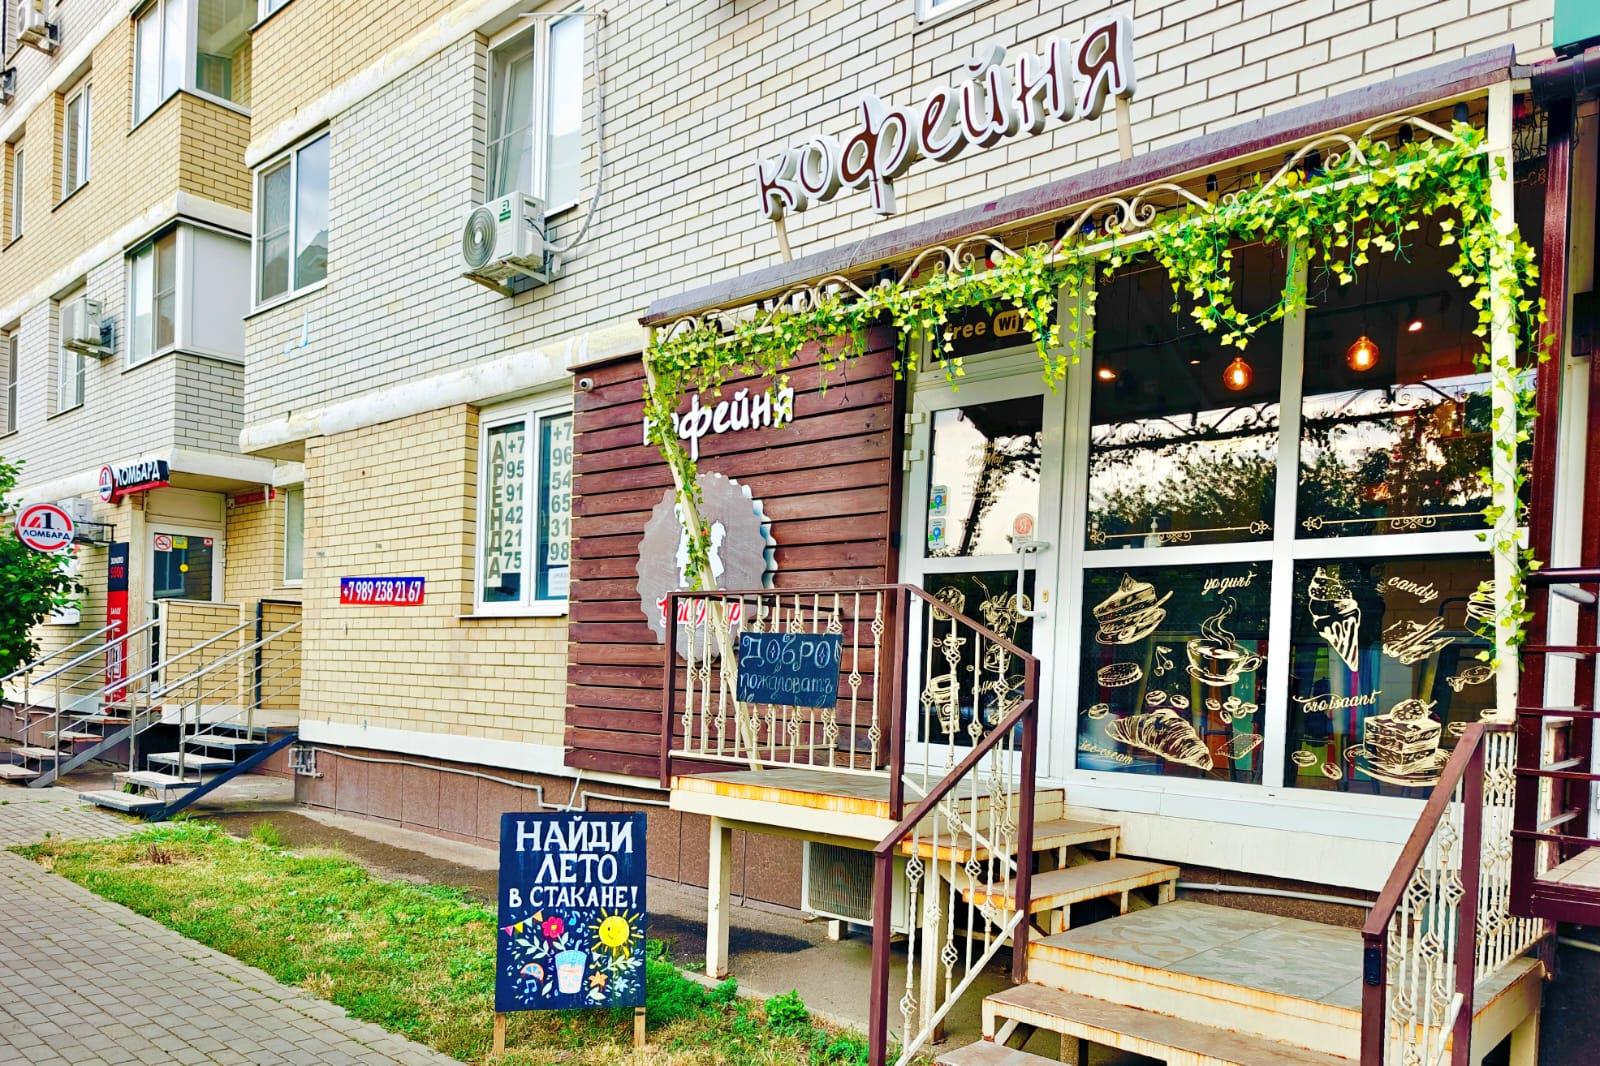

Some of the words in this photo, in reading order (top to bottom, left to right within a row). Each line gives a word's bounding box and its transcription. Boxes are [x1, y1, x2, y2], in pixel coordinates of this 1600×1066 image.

[756, 13, 1137, 218] кофейня
[116, 461, 161, 487] ЛОМБАРД
[506, 460, 525, 479] 95
[506, 483, 524, 502] 91
[488, 440, 505, 579] АРЕНДА
[505, 505, 523, 524] 42
[22, 529, 71, 541] ЛОМБАРД
[504, 528, 522, 548] 21
[503, 551, 522, 569] 75
[343, 581, 355, 601] +7
[355, 581, 374, 601] 989
[374, 581, 394, 602] 238
[394, 581, 407, 602] 21
[408, 581, 422, 602] 67
[1201, 571, 1257, 595] yogurt
[1388, 576, 1439, 603] candy
[515, 815, 634, 853] НАЙДИ
[534, 853, 618, 884] ЛЕТО
[529, 886, 638, 909] СТАКАНЕ!
